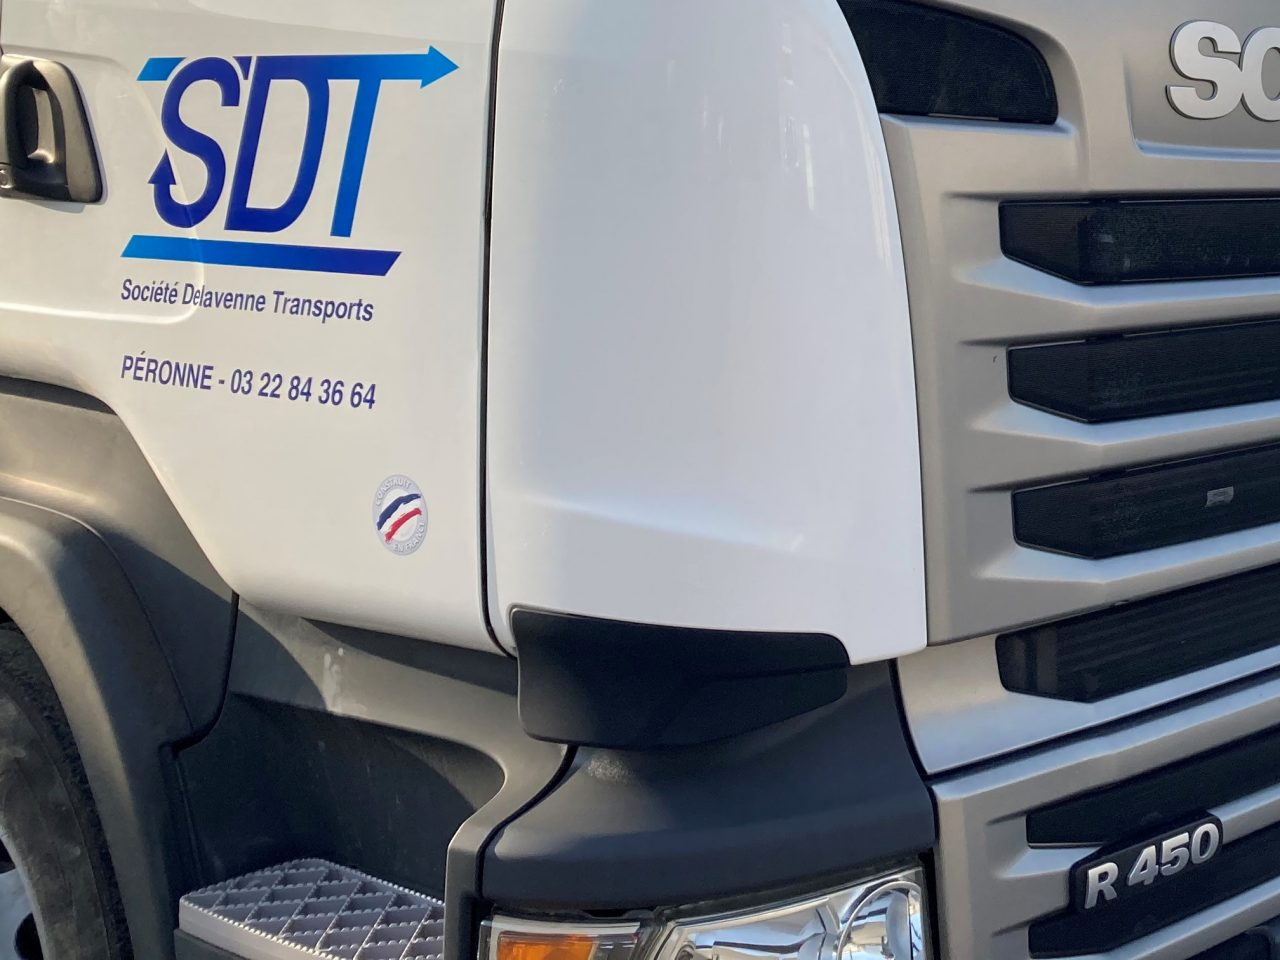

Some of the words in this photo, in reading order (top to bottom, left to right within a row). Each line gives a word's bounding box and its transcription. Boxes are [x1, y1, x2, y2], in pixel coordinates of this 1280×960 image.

[148, 46, 459, 238] SDT
[121, 278, 179, 305] Société
[182, 282, 266, 312] Delavenne
[272, 290, 374, 324] Transports
[121, 350, 214, 390] PÉRONNE
[230, 368, 253, 395] 03
[258, 373, 283, 399] 22
[287, 376, 313, 403] 84
[318, 379, 344, 406] 36
[349, 382, 377, 410] 64
[1084, 861, 1119, 909] R
[1127, 822, 1220, 886] 450
